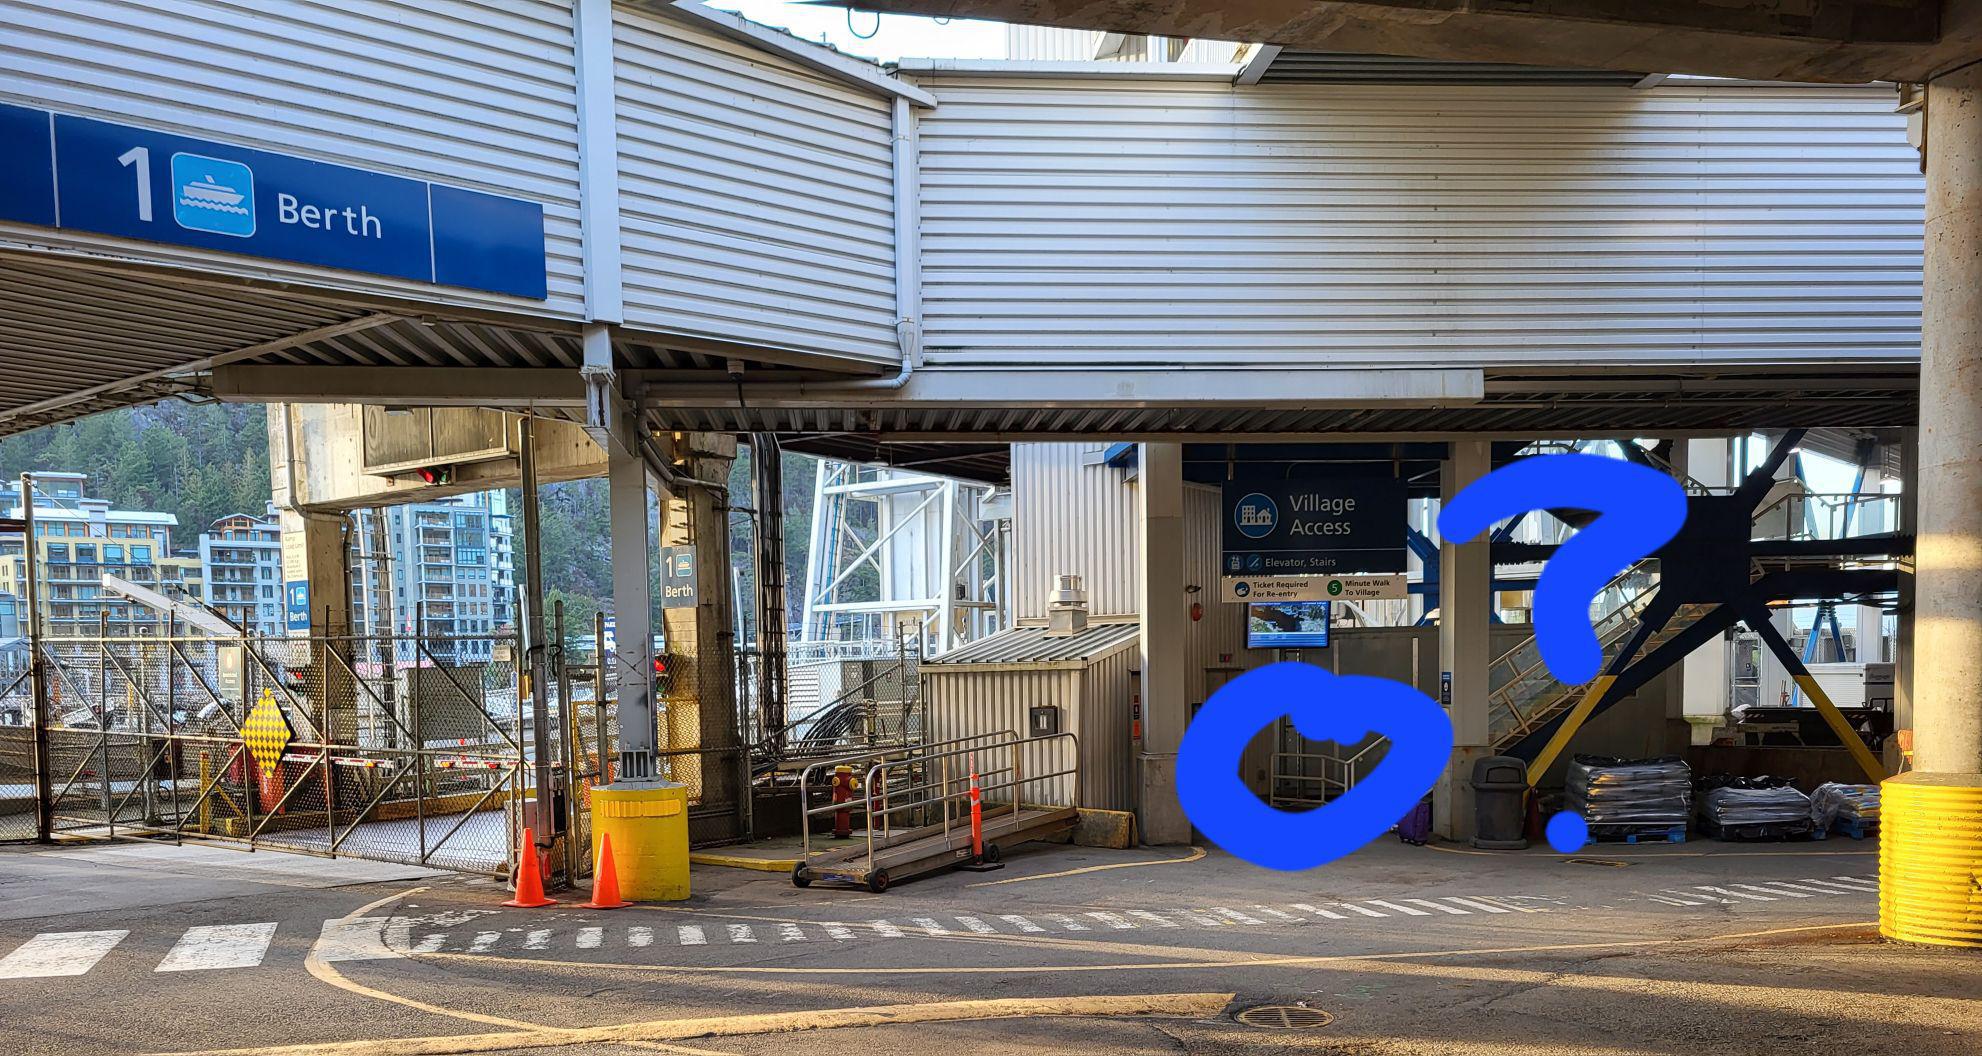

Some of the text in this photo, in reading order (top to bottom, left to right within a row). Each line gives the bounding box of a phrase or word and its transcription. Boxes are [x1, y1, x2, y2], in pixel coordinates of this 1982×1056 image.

[117, 147, 382, 238] 1 Berth
[1289, 494, 1355, 515] Village
[1290, 519, 1351, 535] Access
[666, 556, 673, 577] 1
[1265, 557, 1336, 568] Elevator, Stairs
[665, 584, 693, 598] Berth
[1276, 581, 1308, 589] Required
[1331, 583, 1338, 593] 5
[289, 587, 295, 606] 1
[1266, 590, 1298, 598] Re-entry
[1355, 588, 1380, 596] Village
[289, 611, 307, 622] Berth
